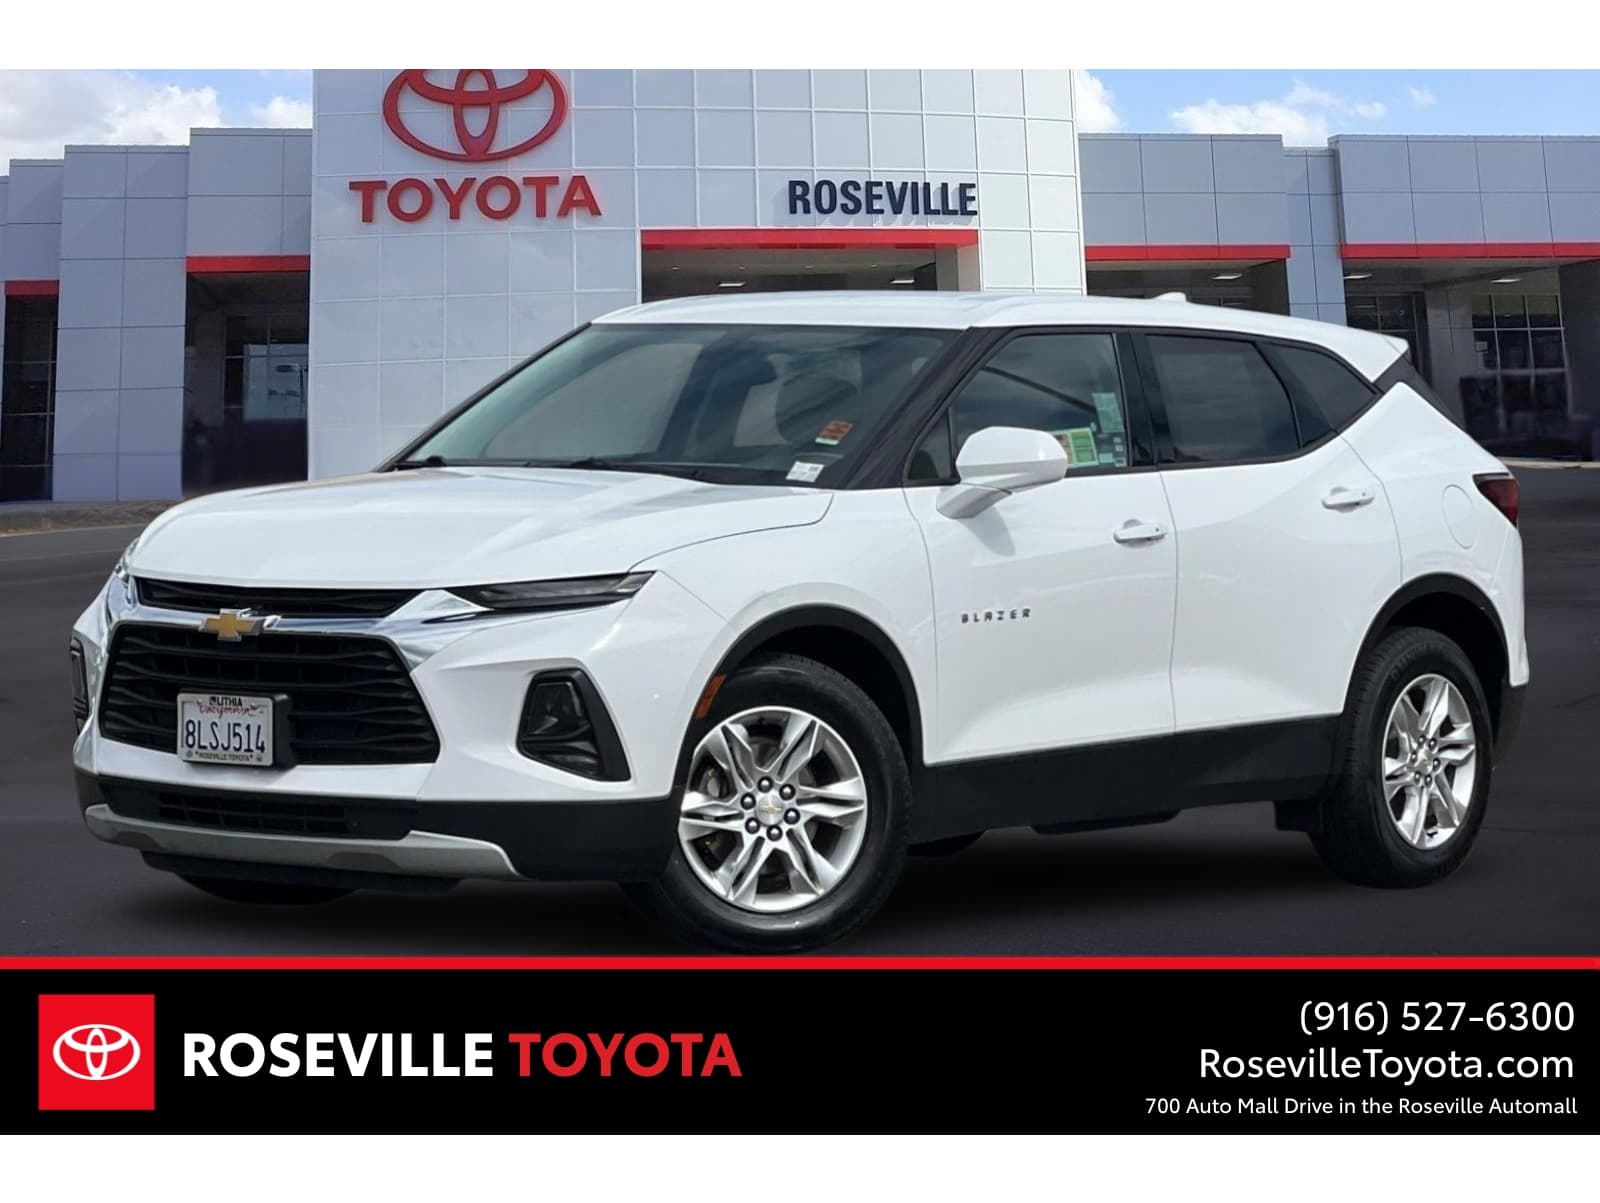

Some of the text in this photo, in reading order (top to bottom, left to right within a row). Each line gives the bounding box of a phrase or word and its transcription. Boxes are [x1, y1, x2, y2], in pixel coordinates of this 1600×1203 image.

[349, 174, 603, 223] TOYOTA
[788, 179, 979, 216] ROSEVILLE
[961, 608, 1031, 623] BLAZER
[185, 719, 266, 752] 8LSJ514
